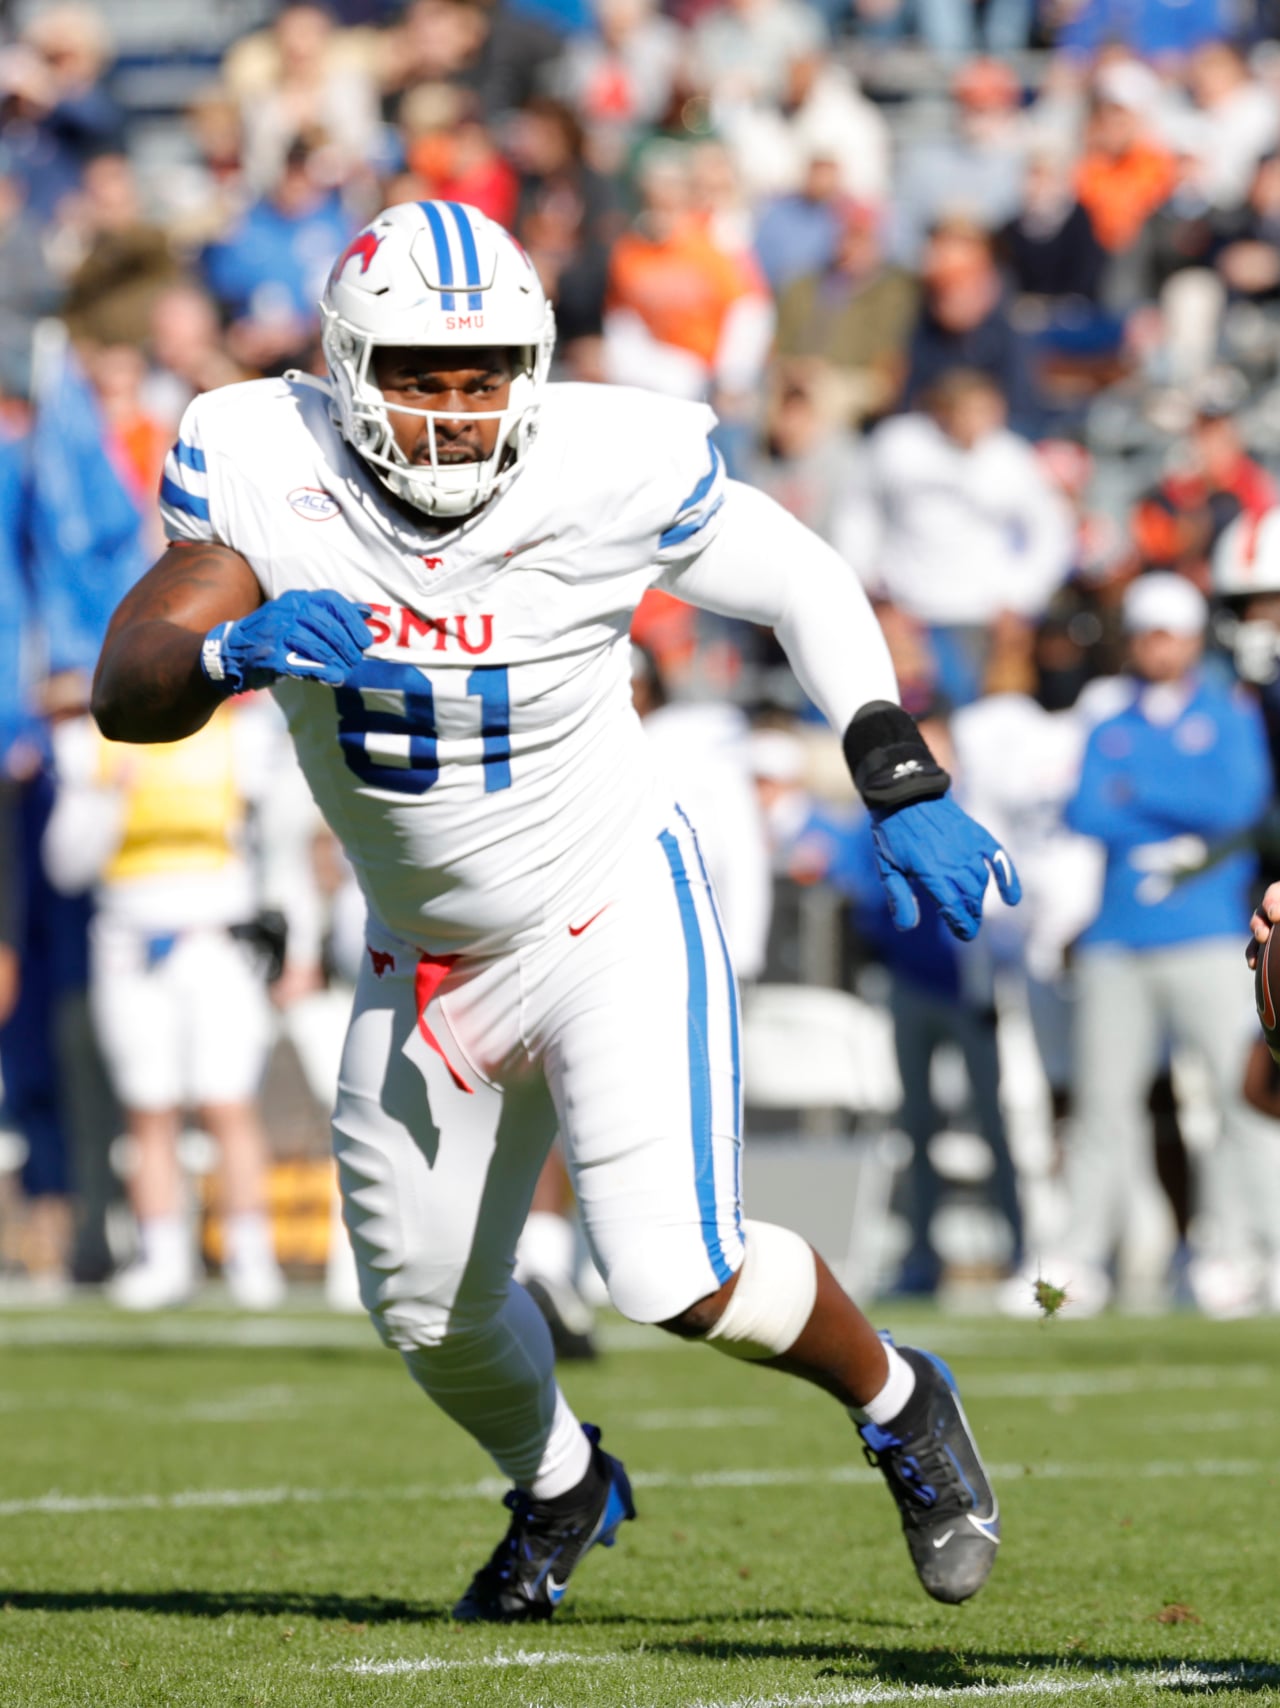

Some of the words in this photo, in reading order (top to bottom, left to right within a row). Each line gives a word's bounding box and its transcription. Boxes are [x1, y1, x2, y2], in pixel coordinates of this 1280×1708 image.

[445, 315, 484, 330] SMU
[290, 495, 334, 511] ACC
[364, 602, 494, 654] SMU
[334, 659, 512, 796] 81
